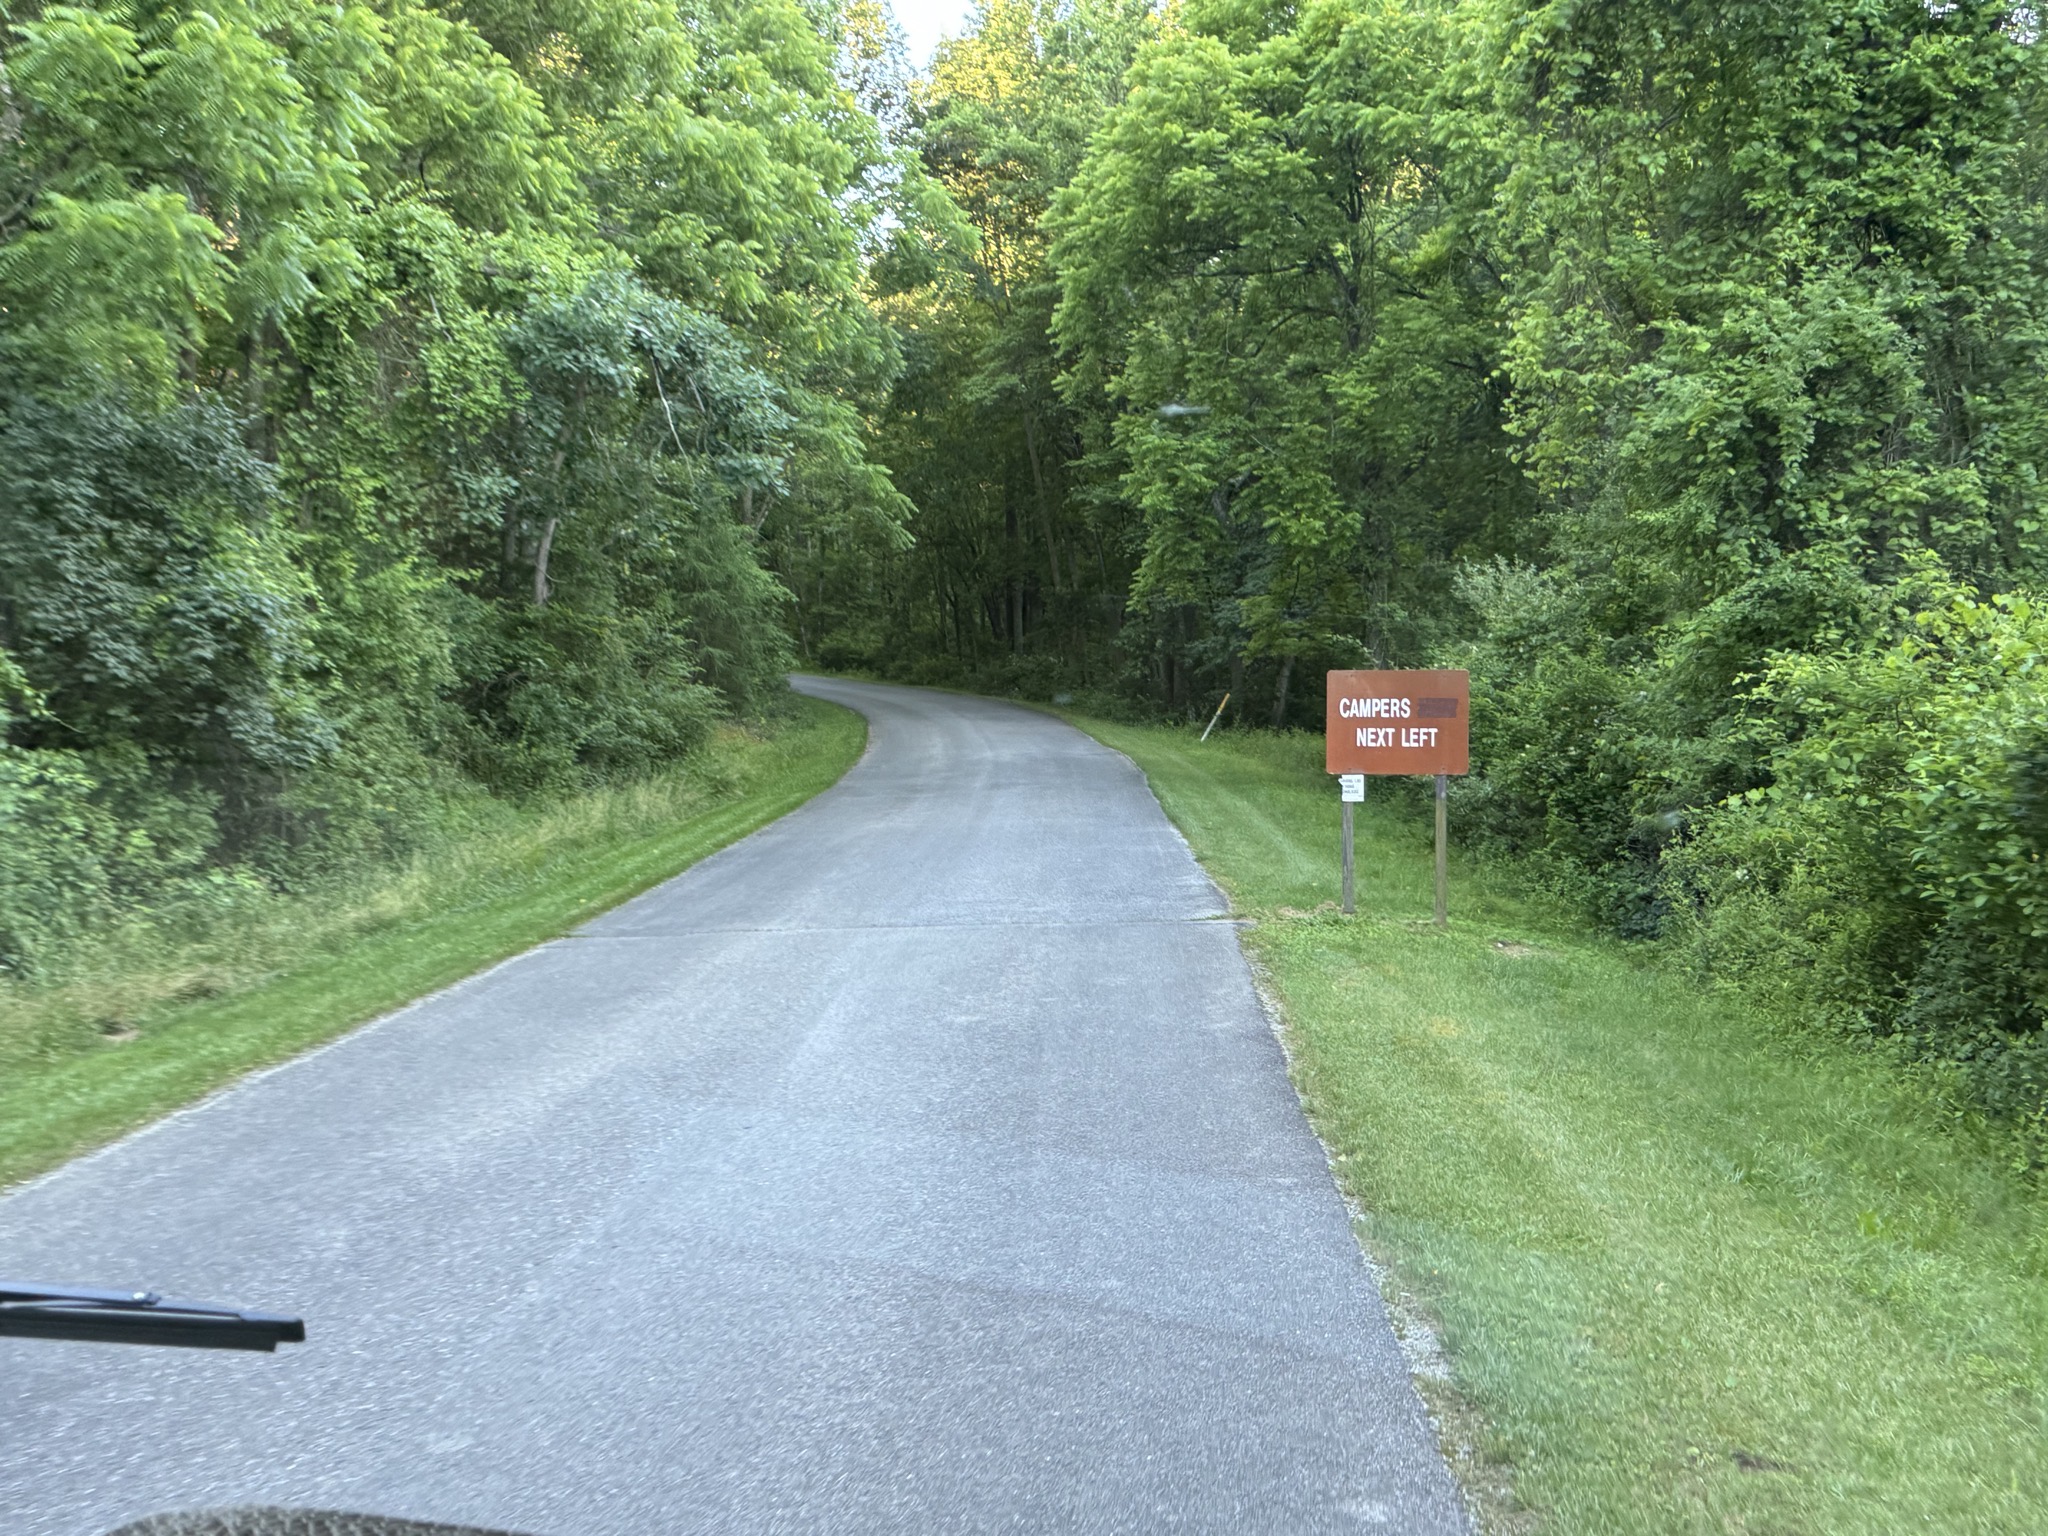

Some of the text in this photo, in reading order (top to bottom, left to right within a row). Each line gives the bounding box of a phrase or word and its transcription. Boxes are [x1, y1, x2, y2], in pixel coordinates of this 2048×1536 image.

[1339, 697, 1411, 718] CAMPERS
[1356, 727, 1438, 748] NEXT LEFT
